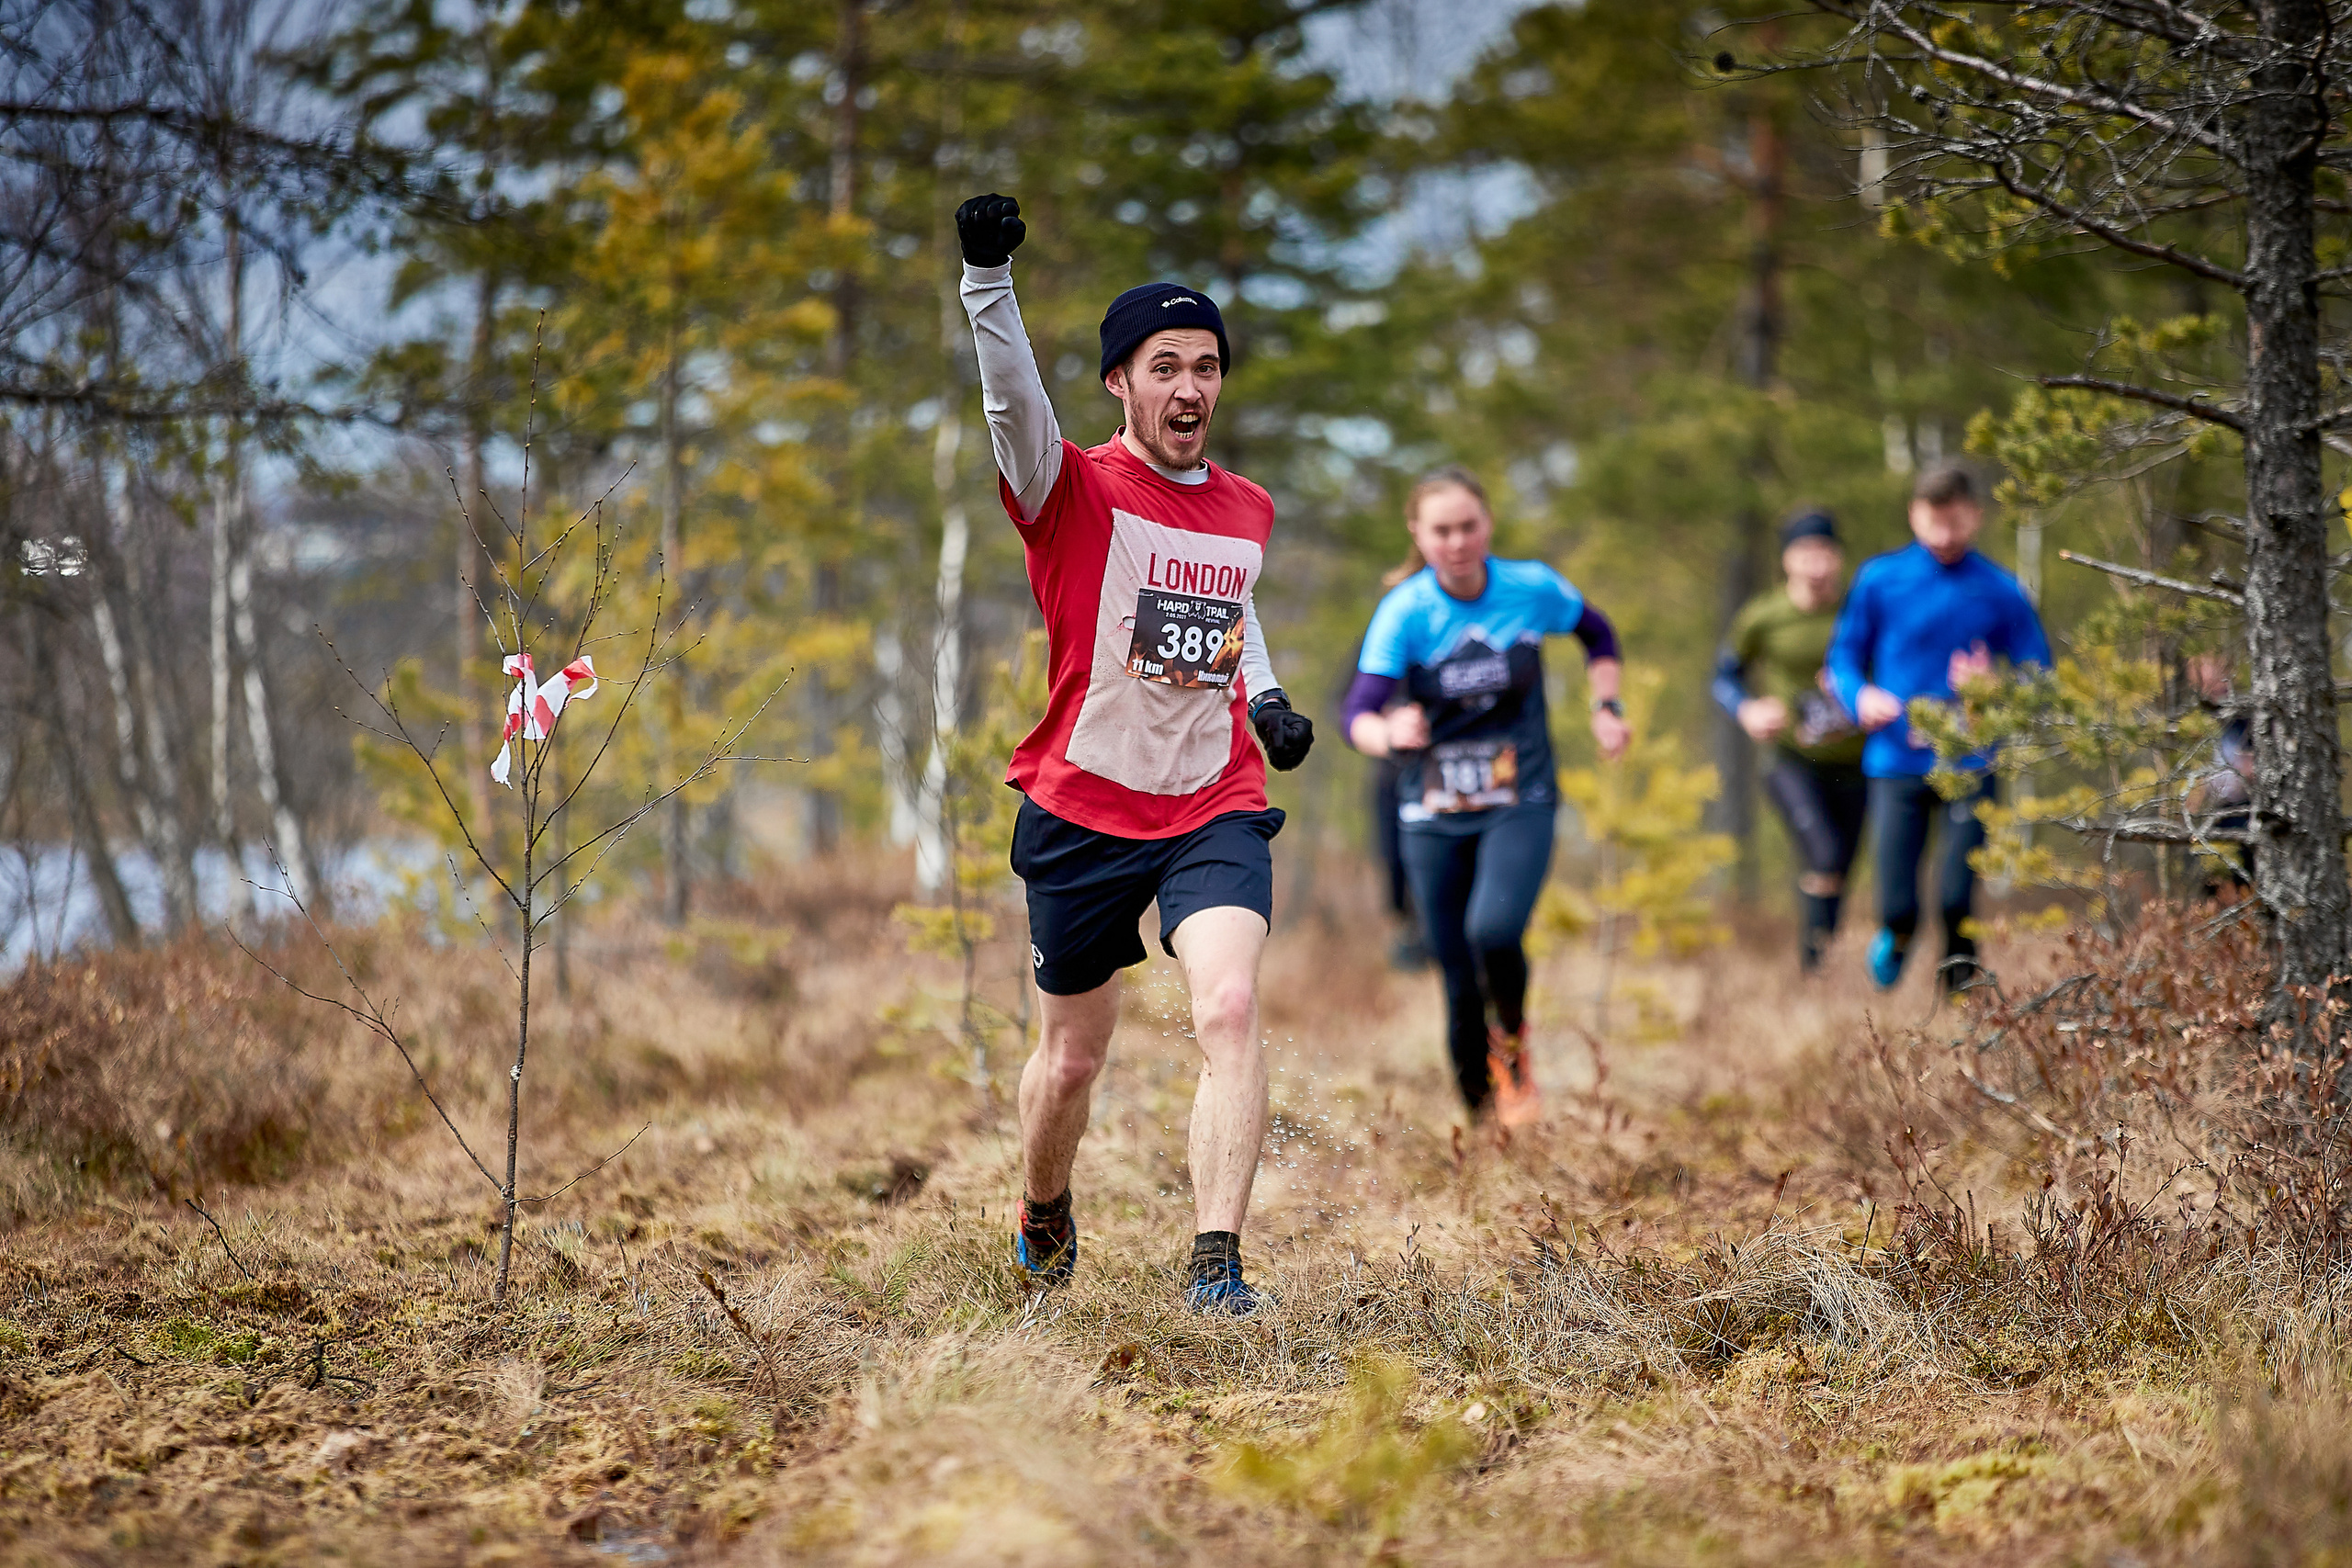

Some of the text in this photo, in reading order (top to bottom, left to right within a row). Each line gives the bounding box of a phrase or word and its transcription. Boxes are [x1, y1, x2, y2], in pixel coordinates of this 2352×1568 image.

[1147, 552, 1247, 600] LONDON
[1157, 599, 1230, 620] HARD TRAIL
[1157, 623, 1225, 665] 389
[1132, 659, 1164, 675] 11 km
